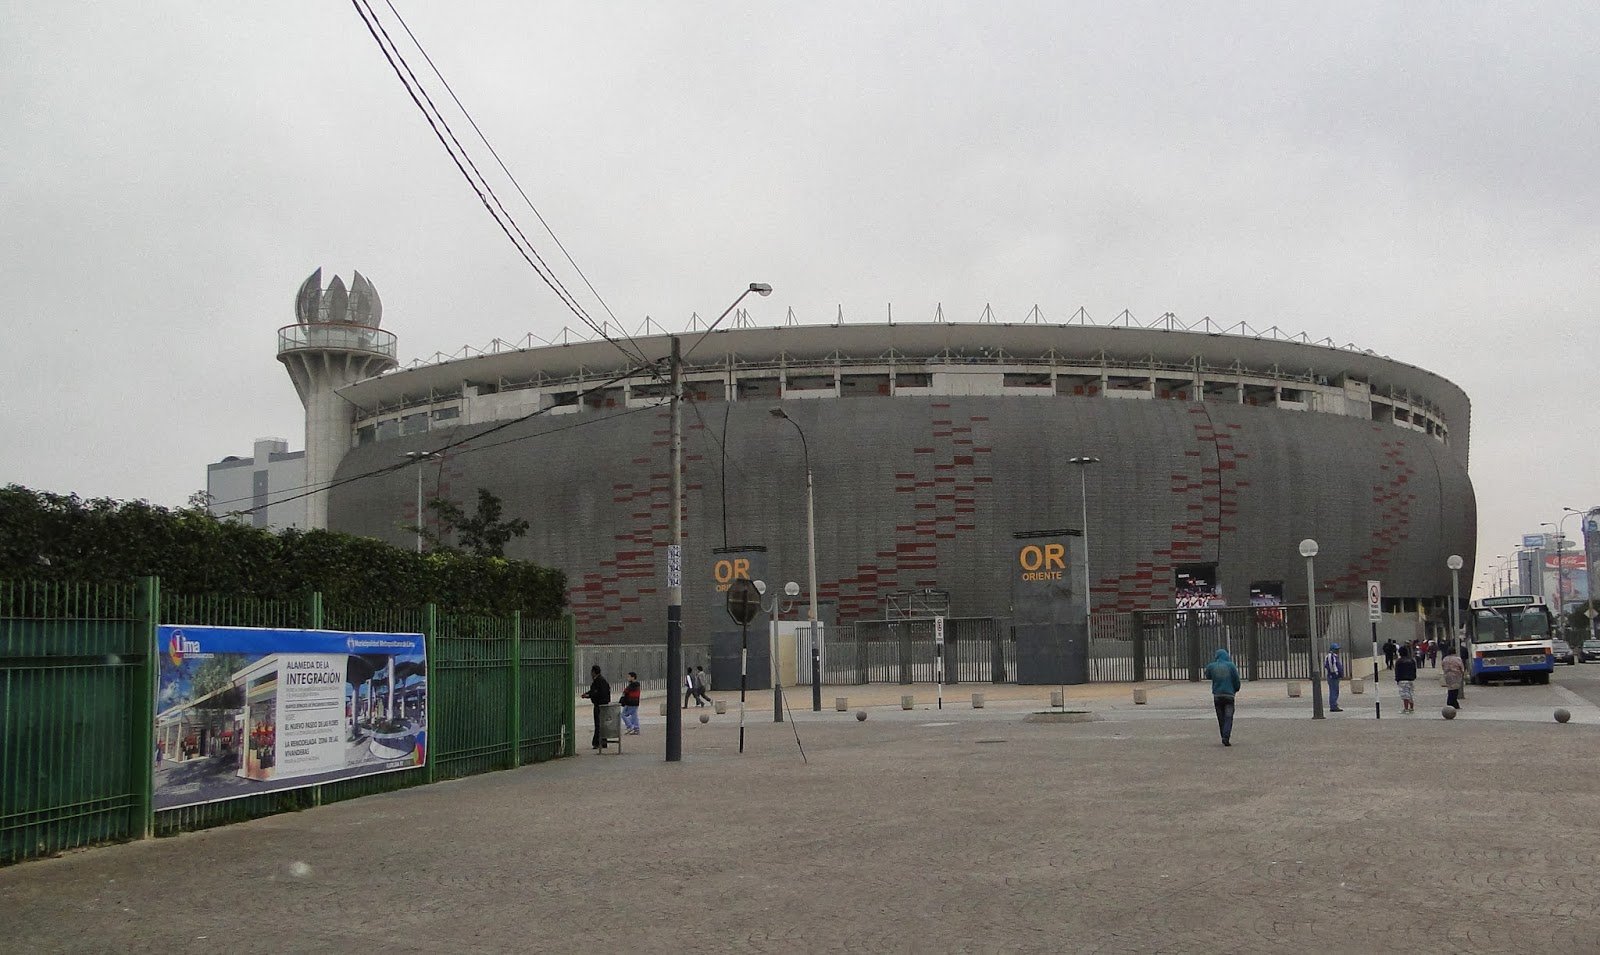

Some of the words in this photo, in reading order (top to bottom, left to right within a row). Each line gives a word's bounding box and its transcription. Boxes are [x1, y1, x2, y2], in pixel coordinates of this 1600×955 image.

[1020, 544, 1066, 571] OR
[714, 558, 750, 583] OR
[1022, 571, 1063, 581] ORIENTE
[175, 634, 200, 653] Lima
[286, 661, 314, 670] ALAMEDA
[316, 661, 323, 669] DE
[323, 661, 330, 669] LA
[286, 669, 340, 684] INTEGRACIÓN
